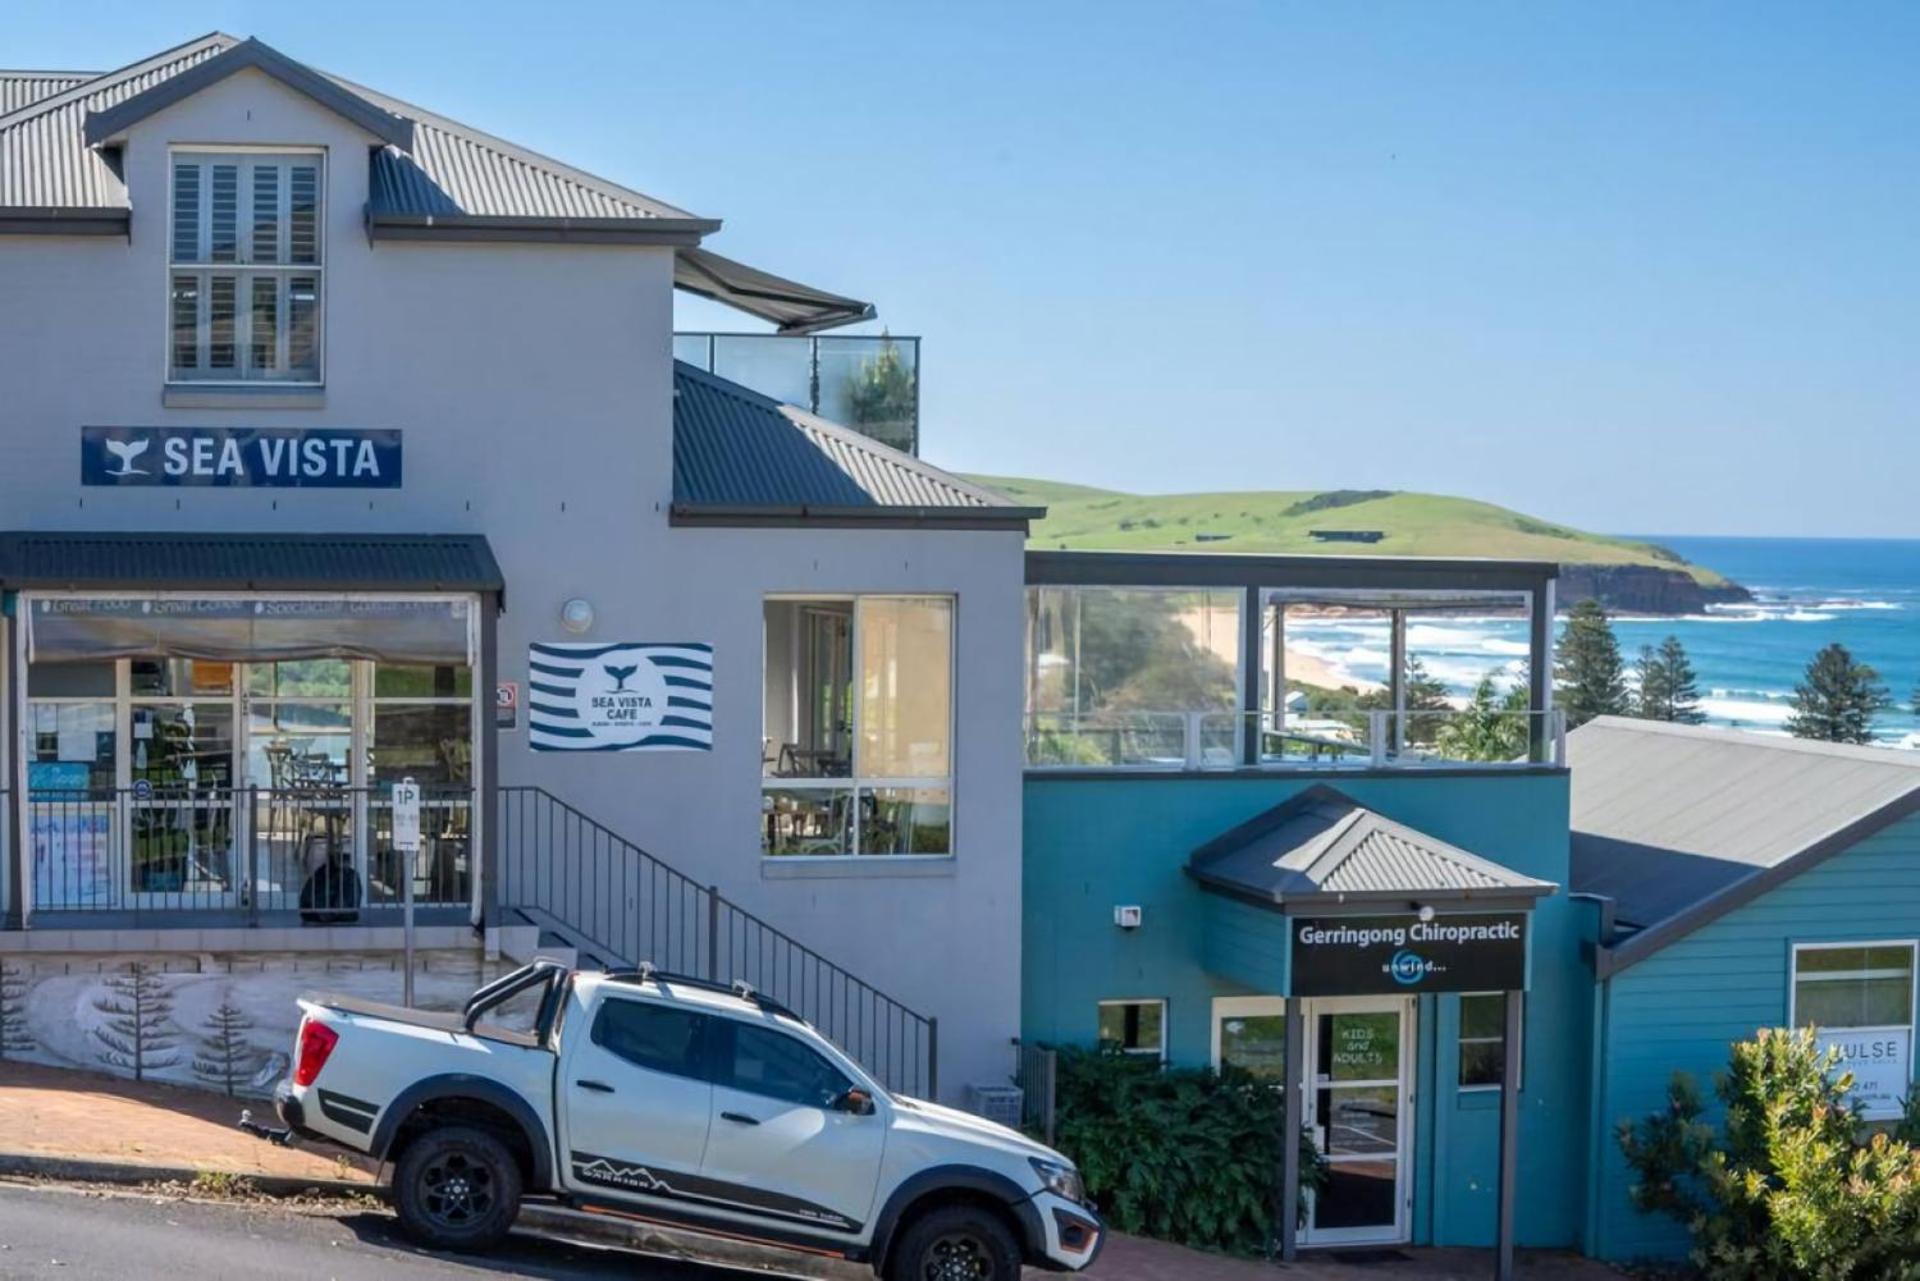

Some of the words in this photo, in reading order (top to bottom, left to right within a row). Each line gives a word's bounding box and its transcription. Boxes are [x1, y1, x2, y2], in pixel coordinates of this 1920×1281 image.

[163, 437, 244, 477] SEA
[259, 438, 381, 477] VISTA
[591, 696, 615, 708] SEA
[618, 696, 652, 708] VISTA
[397, 789, 414, 805] 1P
[1299, 926, 1406, 947] Gerringong
[1409, 921, 1520, 944] Chiropractic
[1341, 1028, 1375, 1040] KIDS
[1833, 1041, 1898, 1059] ULSE
[1333, 1052, 1383, 1065] ADULTS
